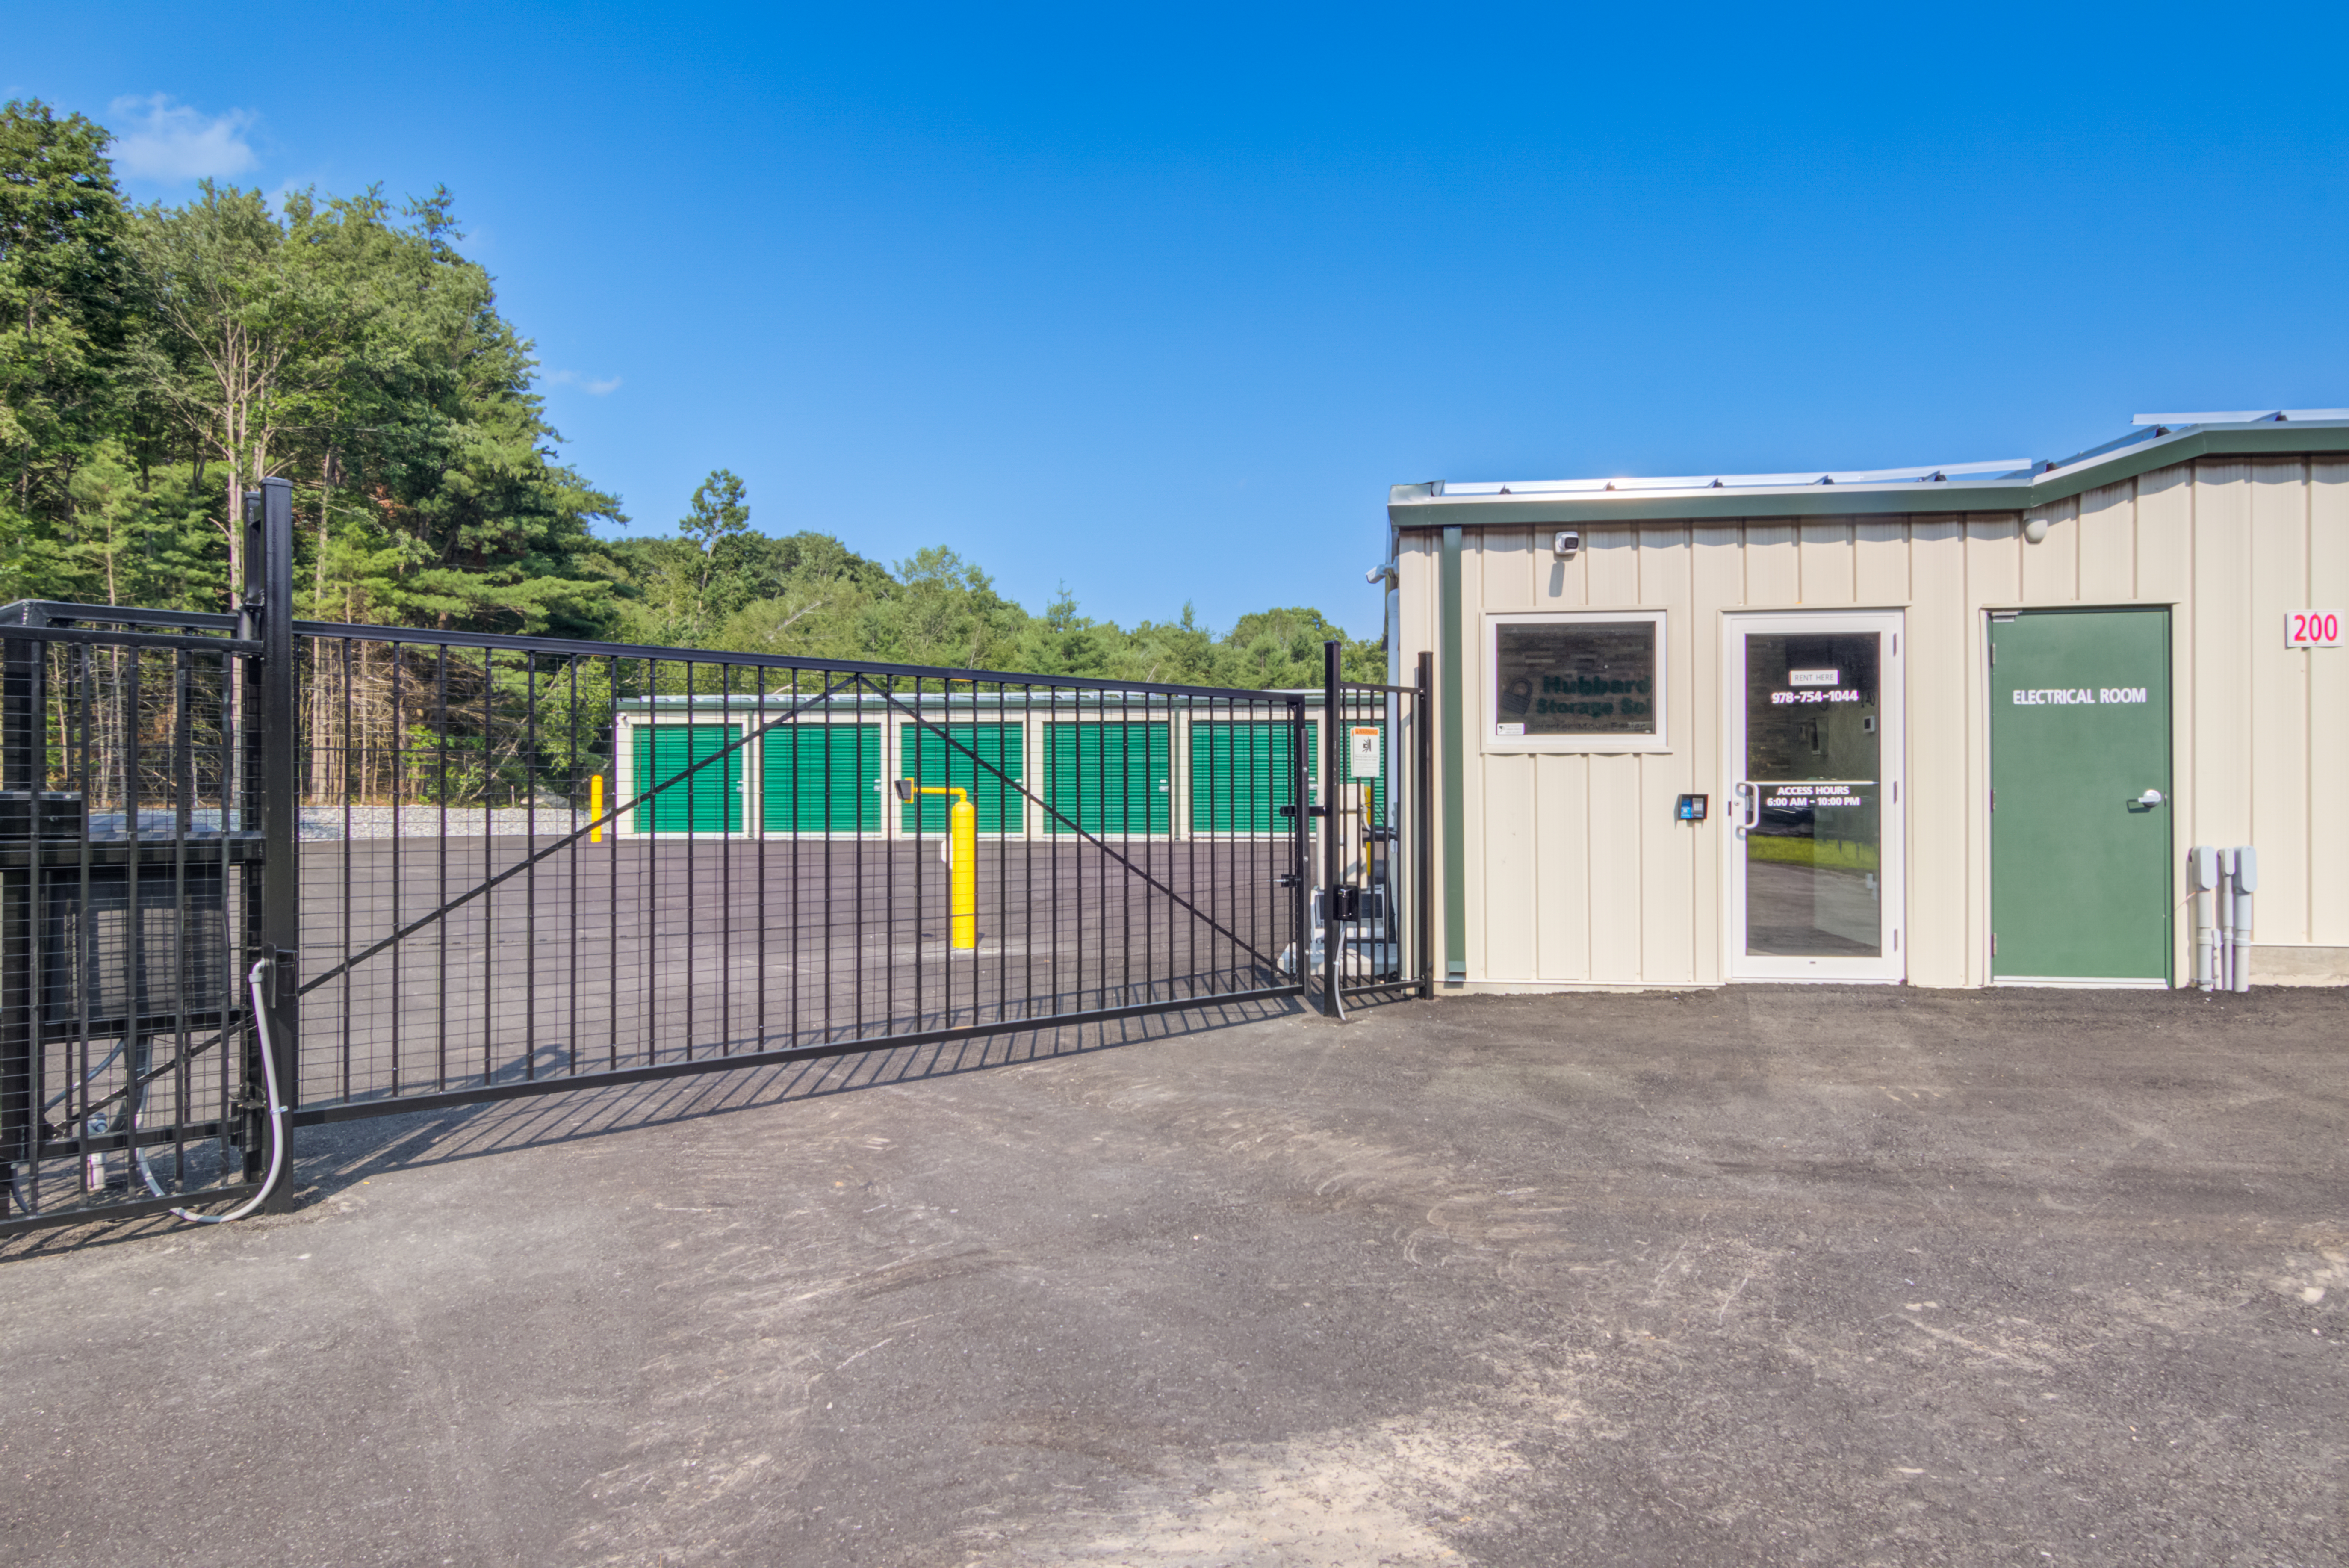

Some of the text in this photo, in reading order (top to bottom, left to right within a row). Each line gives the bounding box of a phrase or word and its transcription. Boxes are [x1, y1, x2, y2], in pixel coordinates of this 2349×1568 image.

[2294, 614, 2337, 641] 200
[1543, 676, 1650, 694] Hubbard
[1772, 690, 1859, 703] 978-754-1044
[2013, 688, 2146, 704] ELECTRICAL ROOM
[1537, 698, 1614, 718] Storage
[1777, 786, 1850, 795] ACCESS HOURS
[1767, 797, 1788, 806] 6:00
[1789, 797, 1808, 806] AM
[1817, 797, 1842, 806] 10:00
[1844, 797, 1860, 806] PM
